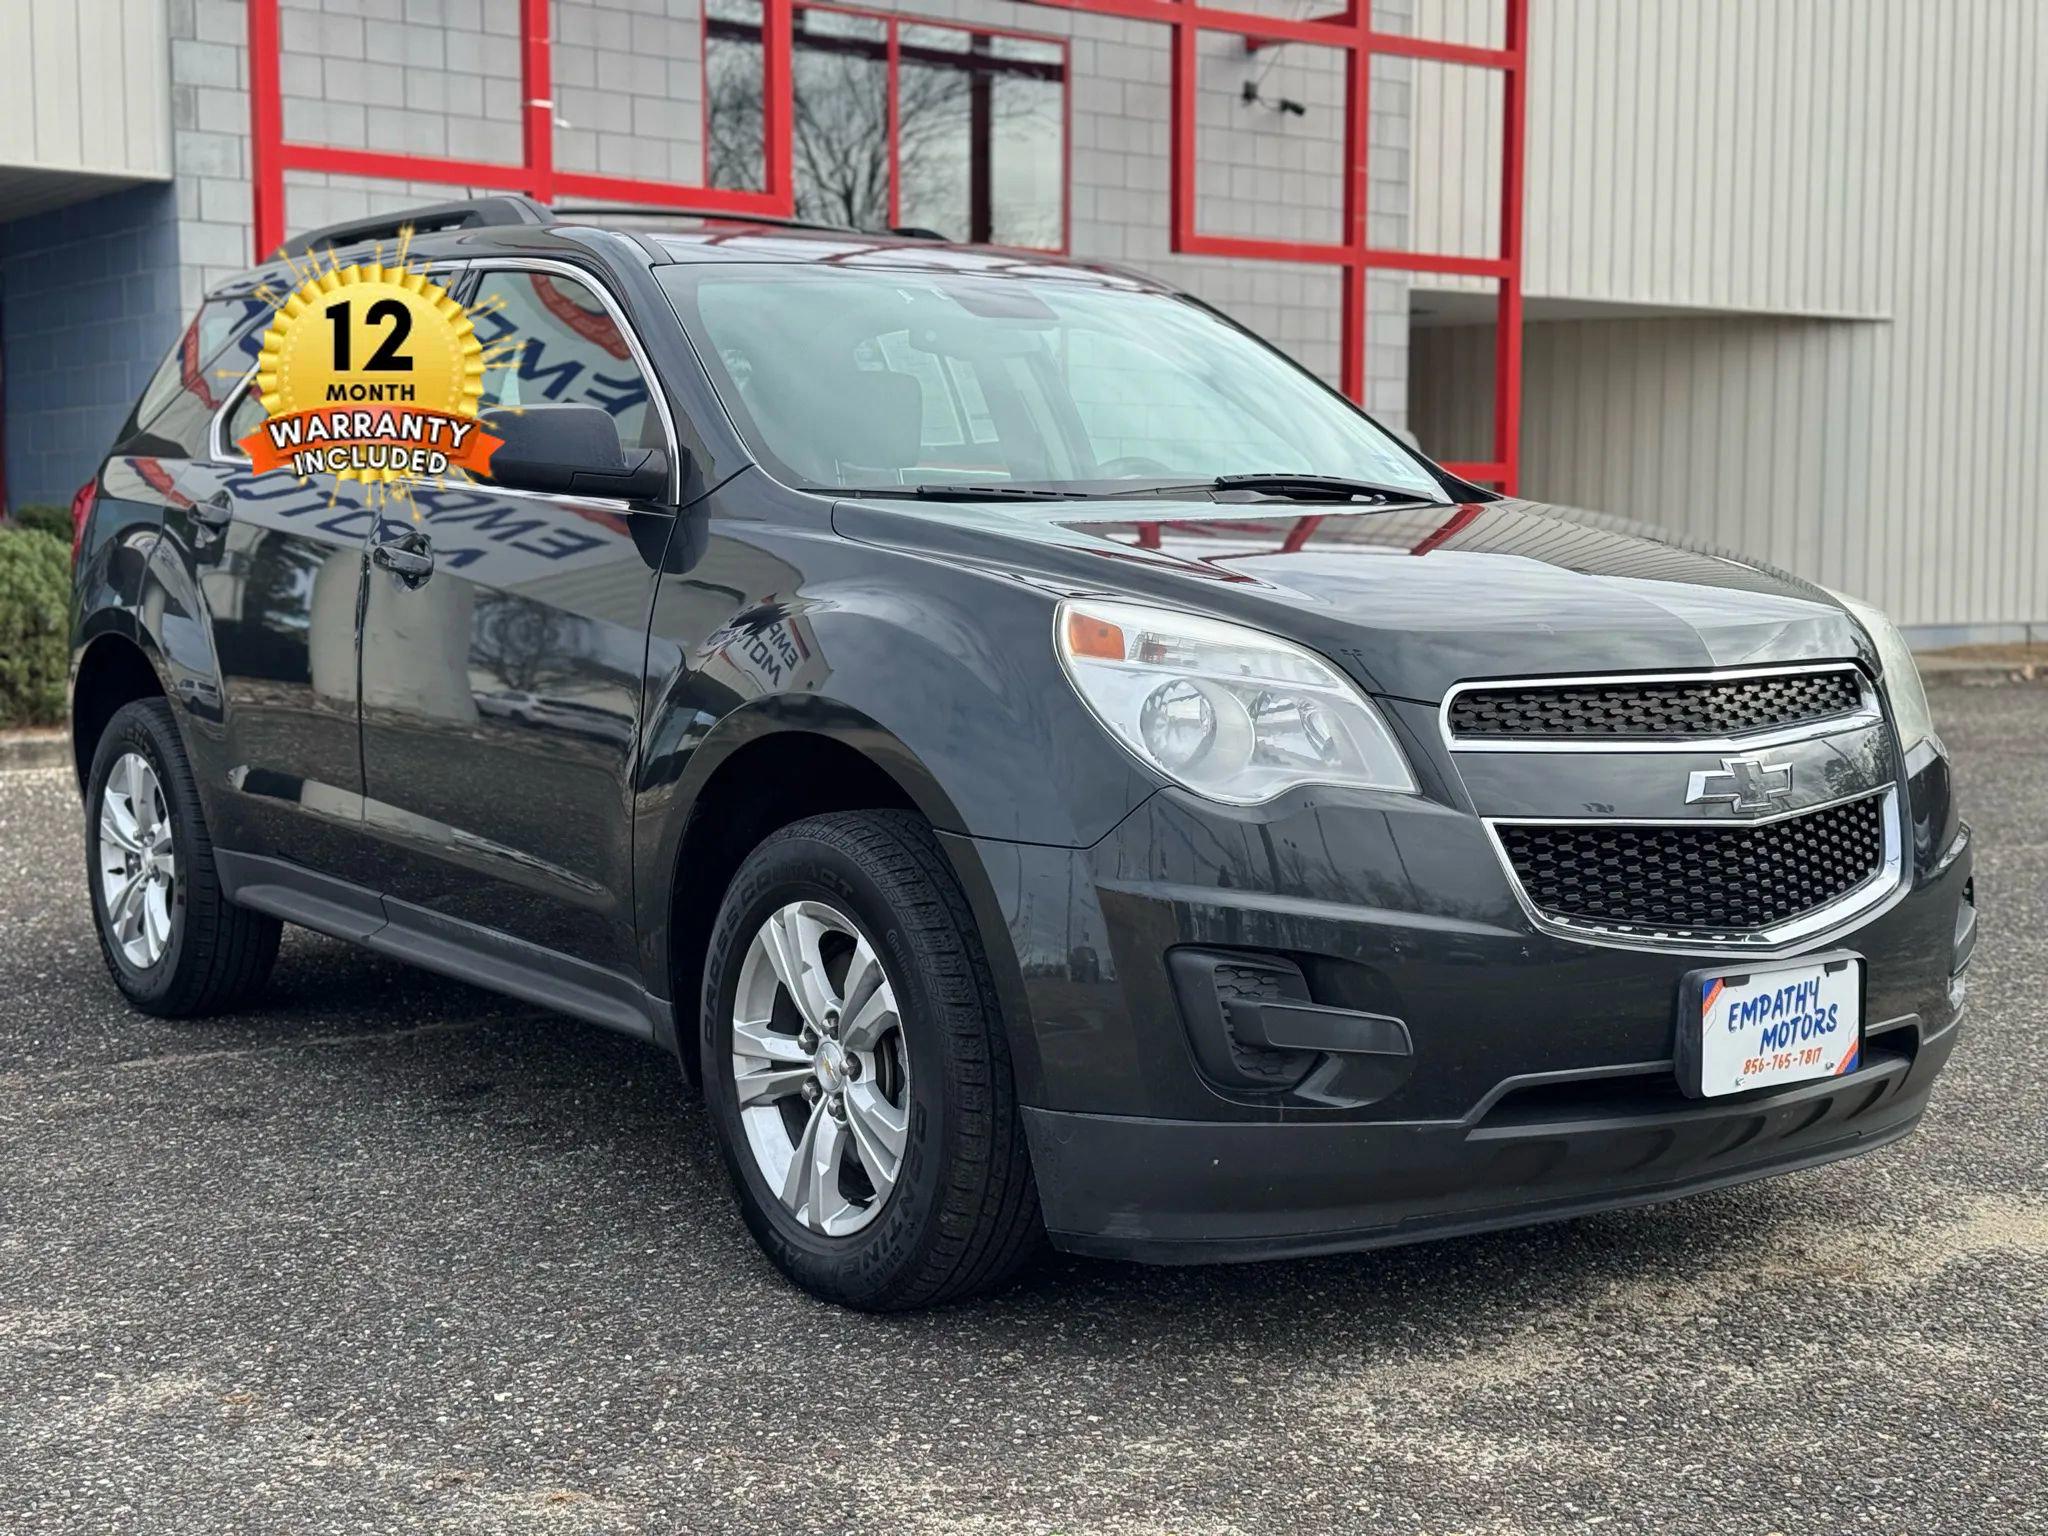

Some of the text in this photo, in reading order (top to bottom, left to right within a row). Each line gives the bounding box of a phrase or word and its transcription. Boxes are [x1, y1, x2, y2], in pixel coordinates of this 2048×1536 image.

[1728, 976, 1820, 1033] EMPATHY
[1760, 1003, 1838, 1056] MOTORS
[1743, 1047, 1823, 1075] 856-765-7817
